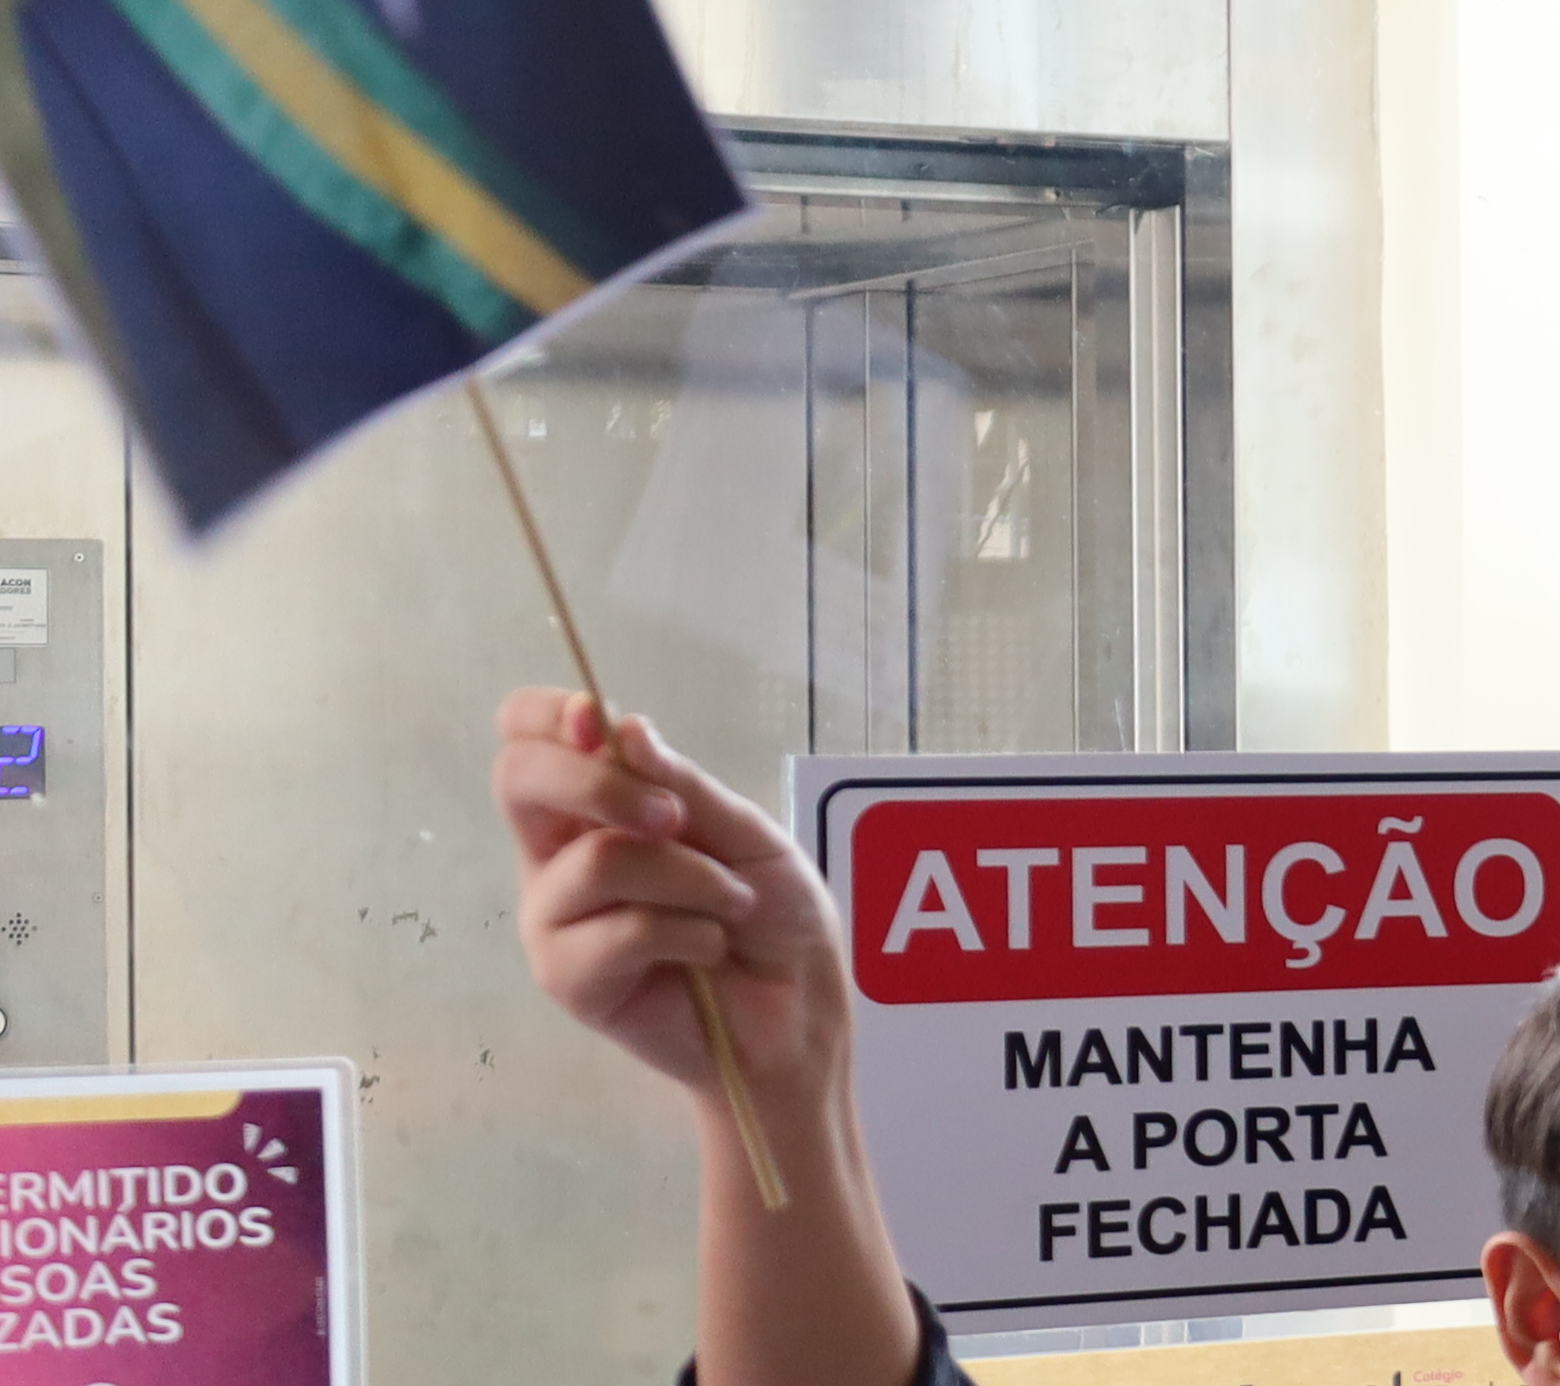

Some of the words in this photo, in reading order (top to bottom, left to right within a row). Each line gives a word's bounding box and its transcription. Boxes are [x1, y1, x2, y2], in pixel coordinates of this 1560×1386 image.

[880, 814, 1546, 969] ATENÇÃO
[1003, 1016, 1437, 1090] MANTENHA
[1053, 1115, 1111, 1175] A
[1132, 1101, 1389, 1171] PORTA
[1037, 1184, 1408, 1263] FECHADA
[0, 1258, 157, 1305] SOAS
